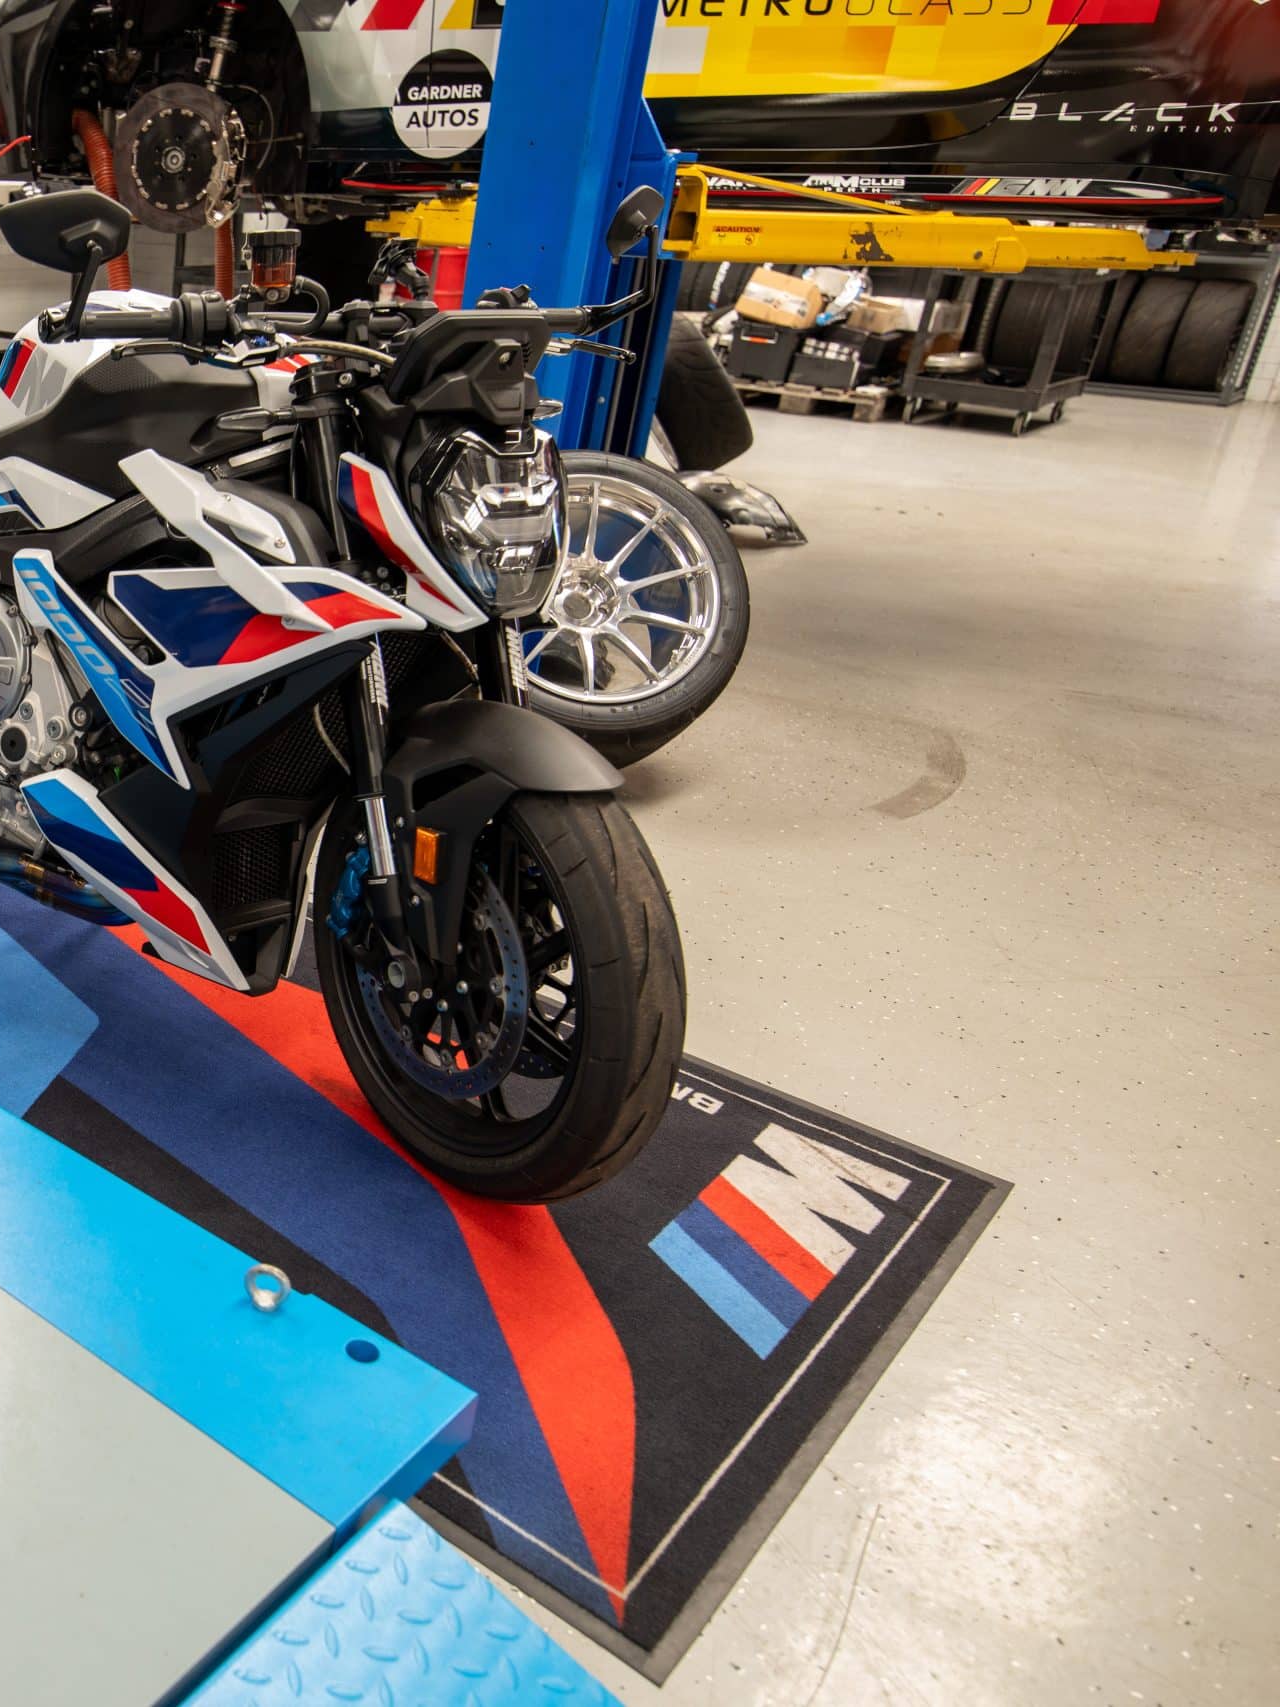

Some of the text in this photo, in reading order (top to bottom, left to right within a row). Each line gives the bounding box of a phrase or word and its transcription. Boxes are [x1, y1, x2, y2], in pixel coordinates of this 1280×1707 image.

[407, 84, 483, 101] GARDNER
[406, 109, 480, 129] AUTOS
[1009, 102, 1241, 122] BLACK
[1129, 125, 1234, 133] EDITION
